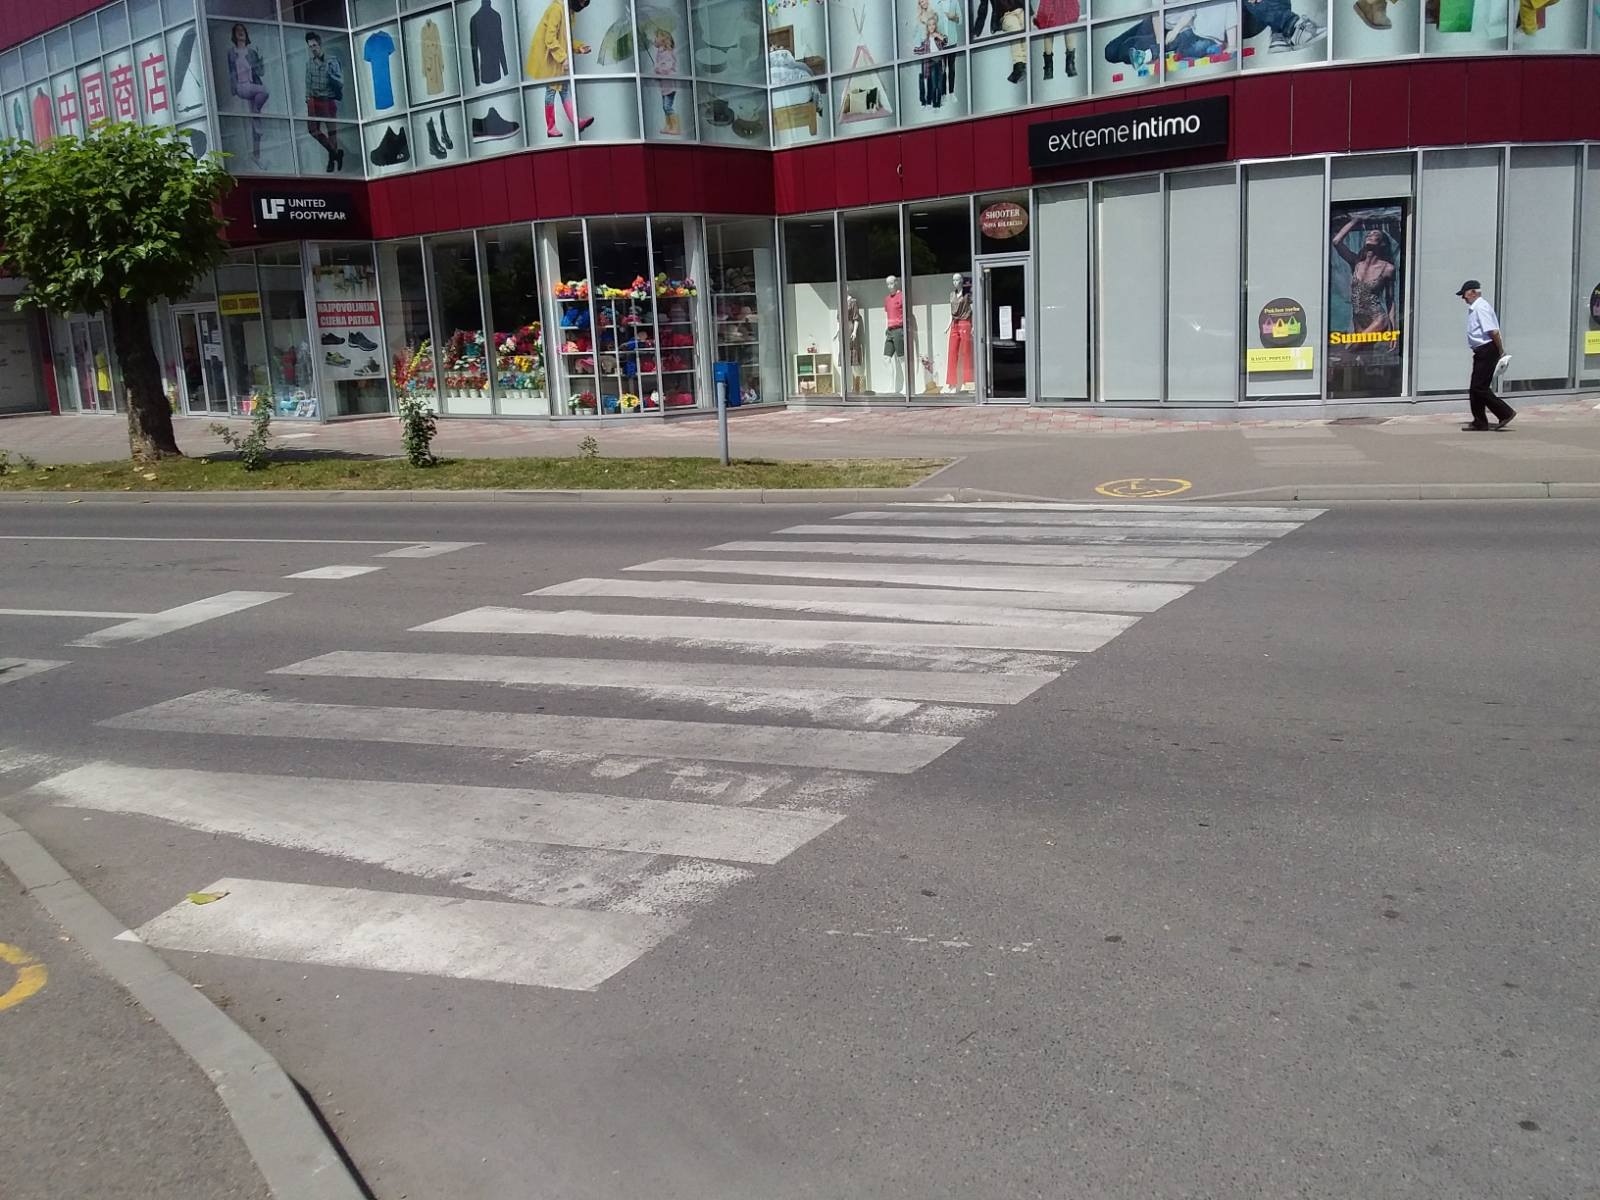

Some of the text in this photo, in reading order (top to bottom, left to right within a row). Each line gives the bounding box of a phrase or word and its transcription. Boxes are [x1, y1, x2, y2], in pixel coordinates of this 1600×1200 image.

[57, 52, 169, 135] 中国商店
[1048, 114, 1201, 152] extreme intimo
[288, 199, 326, 208] UNITED
[289, 211, 346, 220] FOOTWEAR
[985, 208, 1020, 219] SHOOTER
[1330, 330, 1400, 345] Summer
